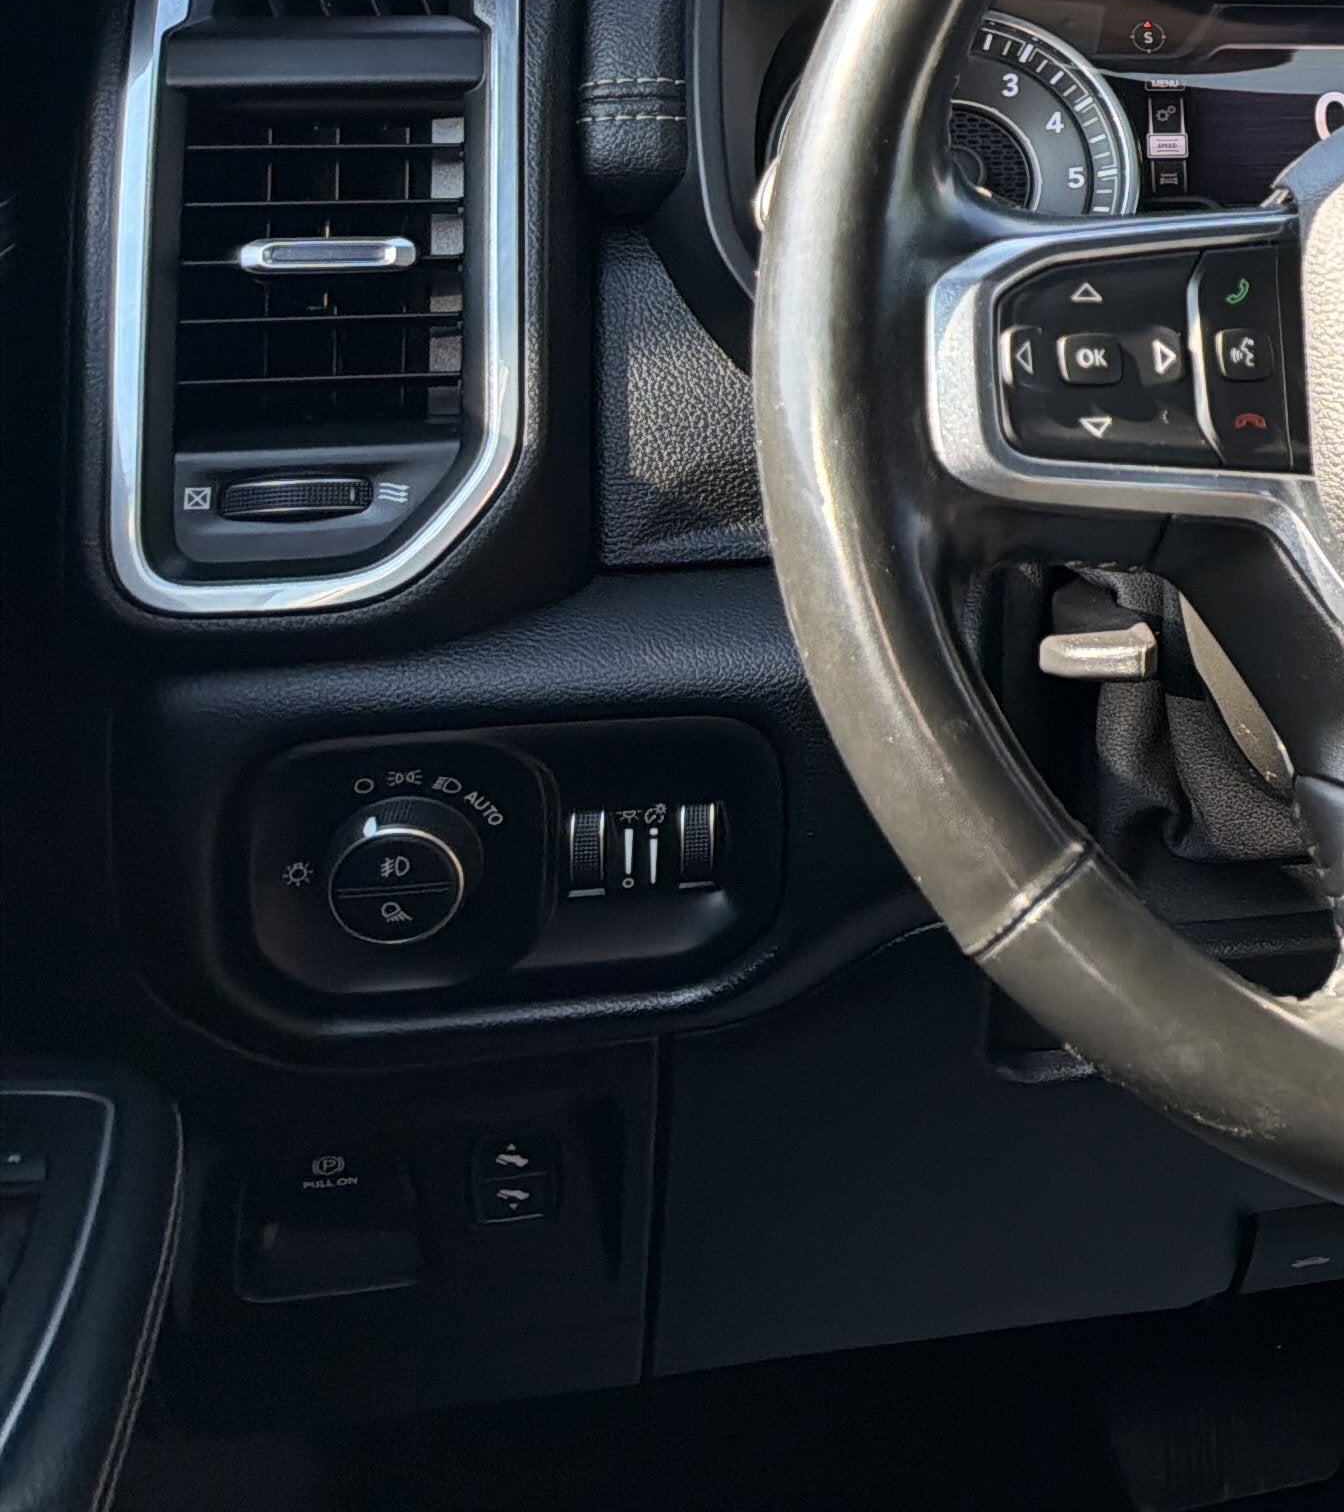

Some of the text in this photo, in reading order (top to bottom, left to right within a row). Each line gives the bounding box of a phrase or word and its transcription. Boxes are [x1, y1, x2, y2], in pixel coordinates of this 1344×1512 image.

[1001, 72, 1019, 98] 3
[1151, 79, 1179, 88] MENU
[1045, 110, 1065, 134] 4
[1067, 166, 1086, 189] 5
[1074, 346, 1109, 369] OK
[463, 790, 505, 826] AUTO
[302, 1176, 359, 1189] PULL ON
